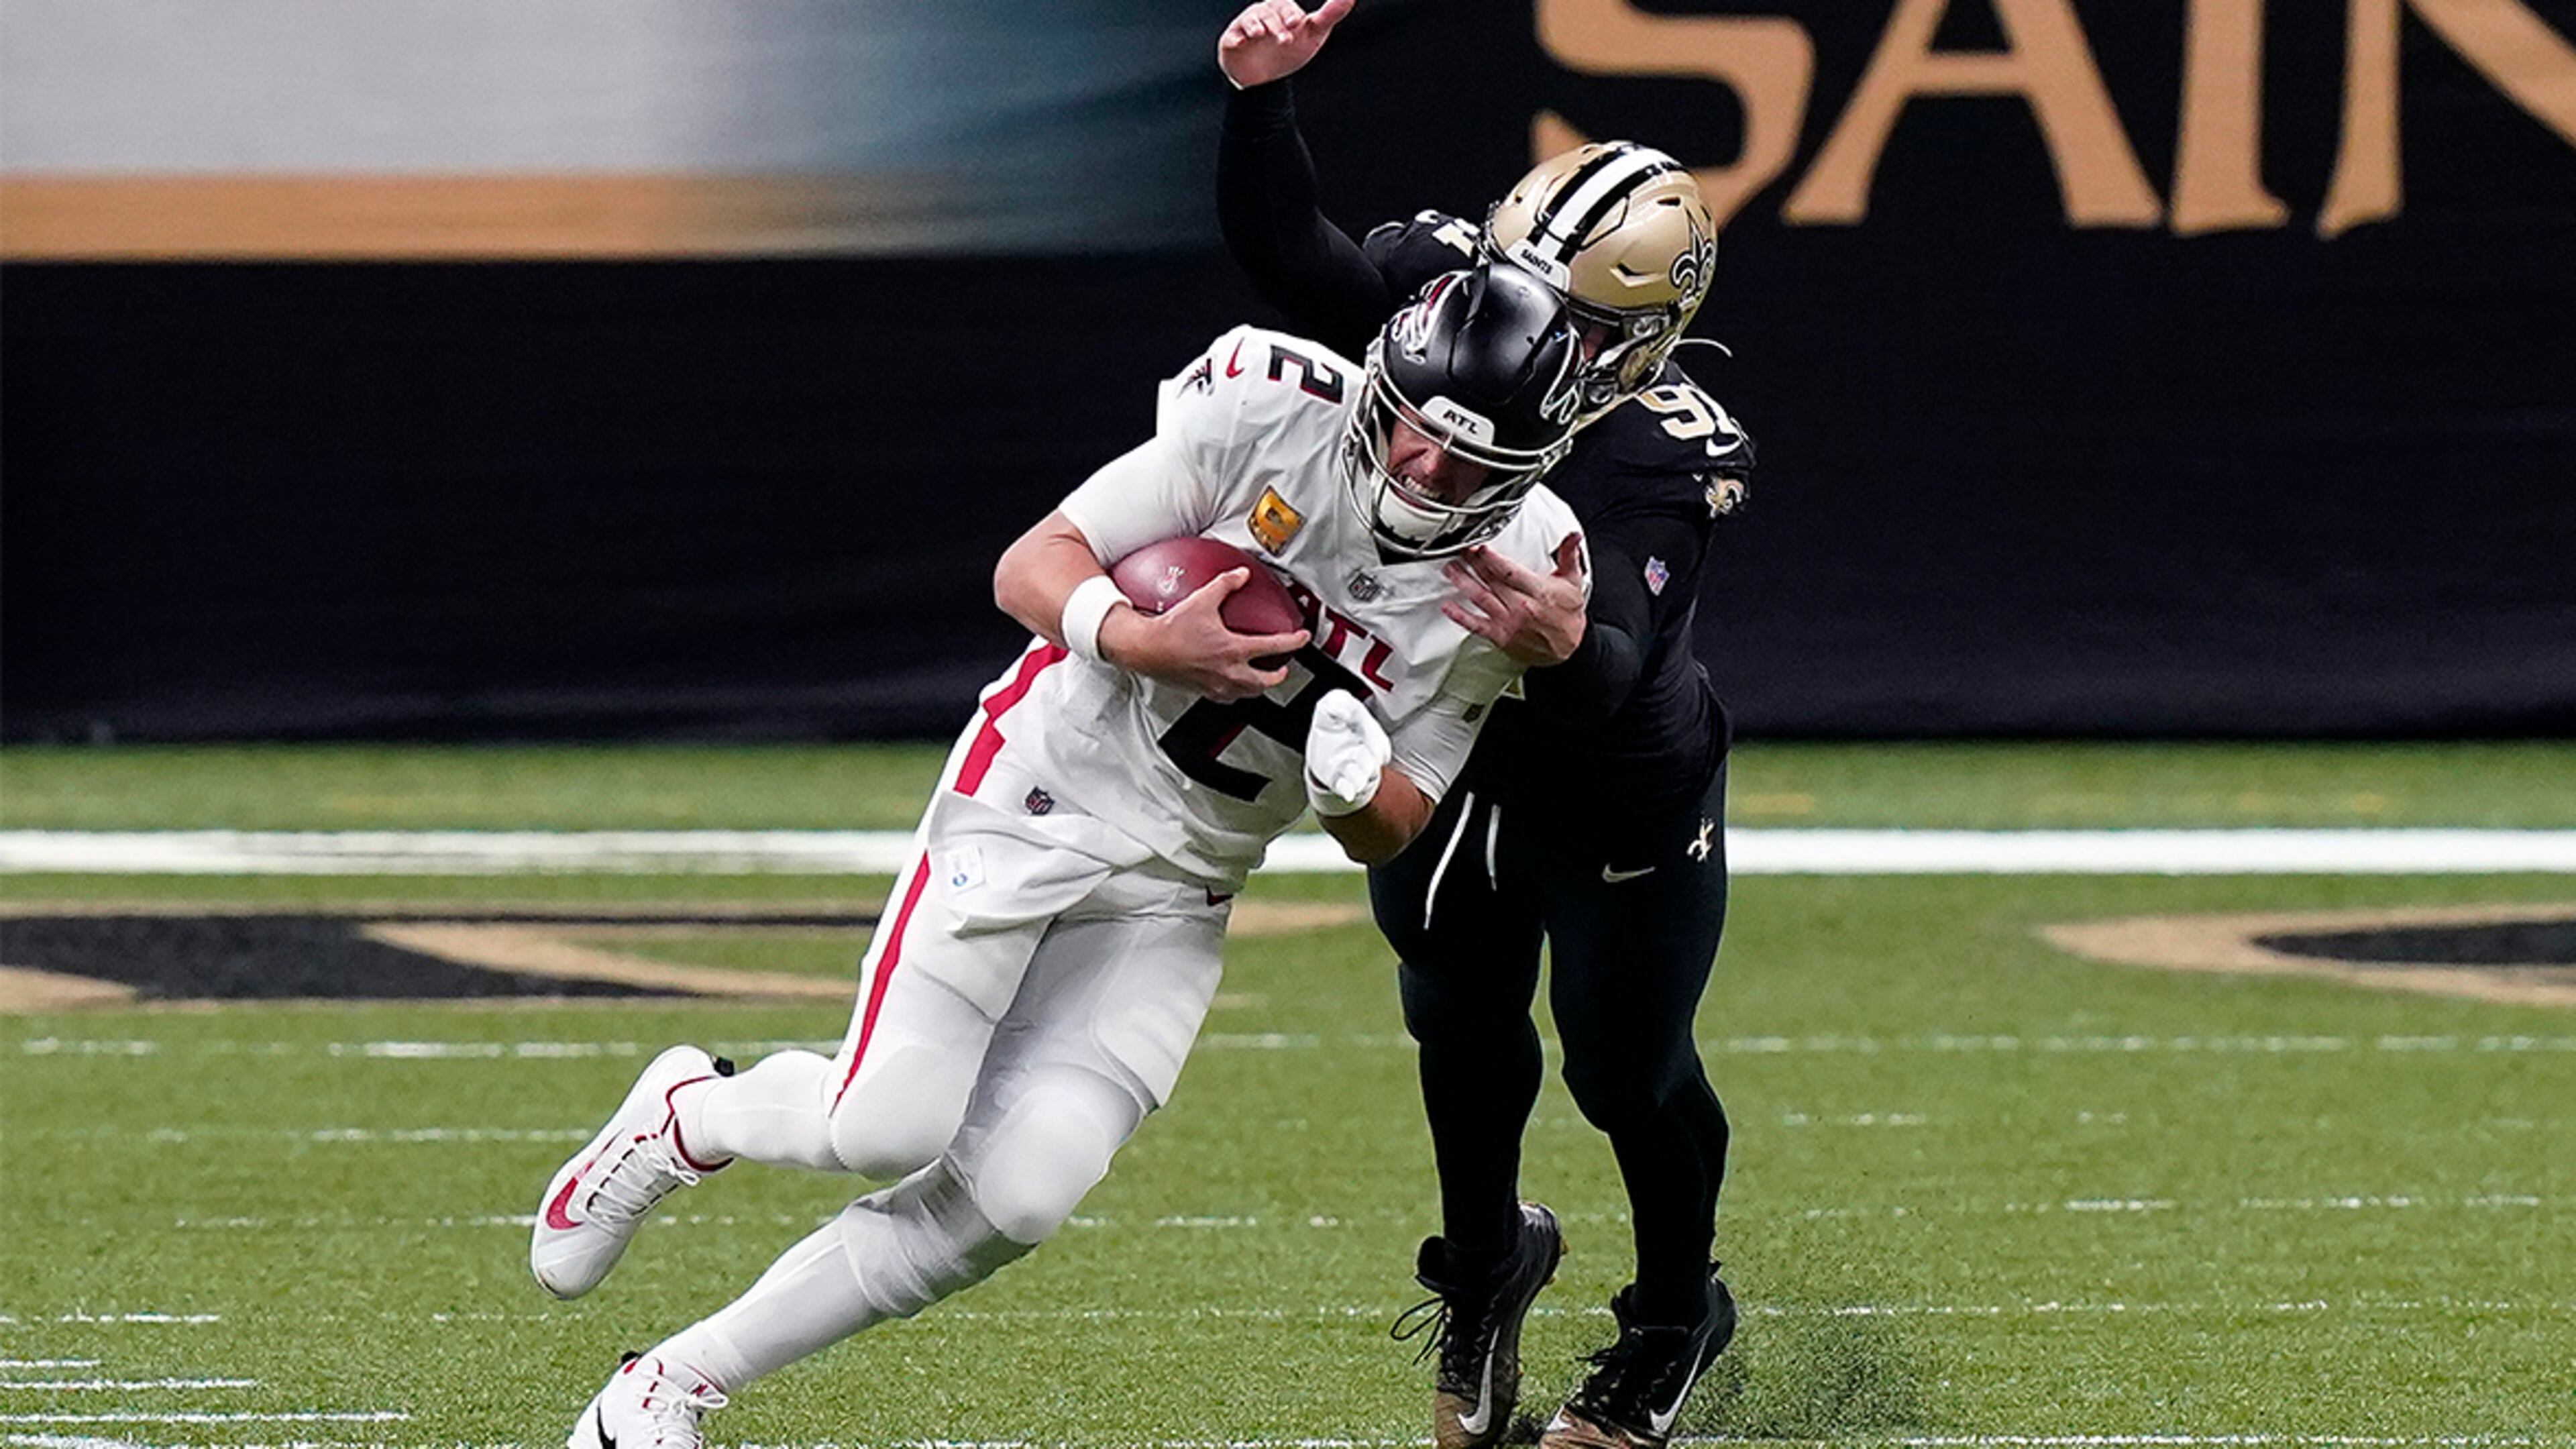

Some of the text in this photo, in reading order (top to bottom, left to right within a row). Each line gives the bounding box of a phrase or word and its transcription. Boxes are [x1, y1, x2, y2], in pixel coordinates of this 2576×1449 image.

[1268, 345, 1343, 404] 2
[1443, 409, 1477, 435] ATL
[1285, 574, 1395, 692] ATL
[1156, 641, 1373, 803] 2
